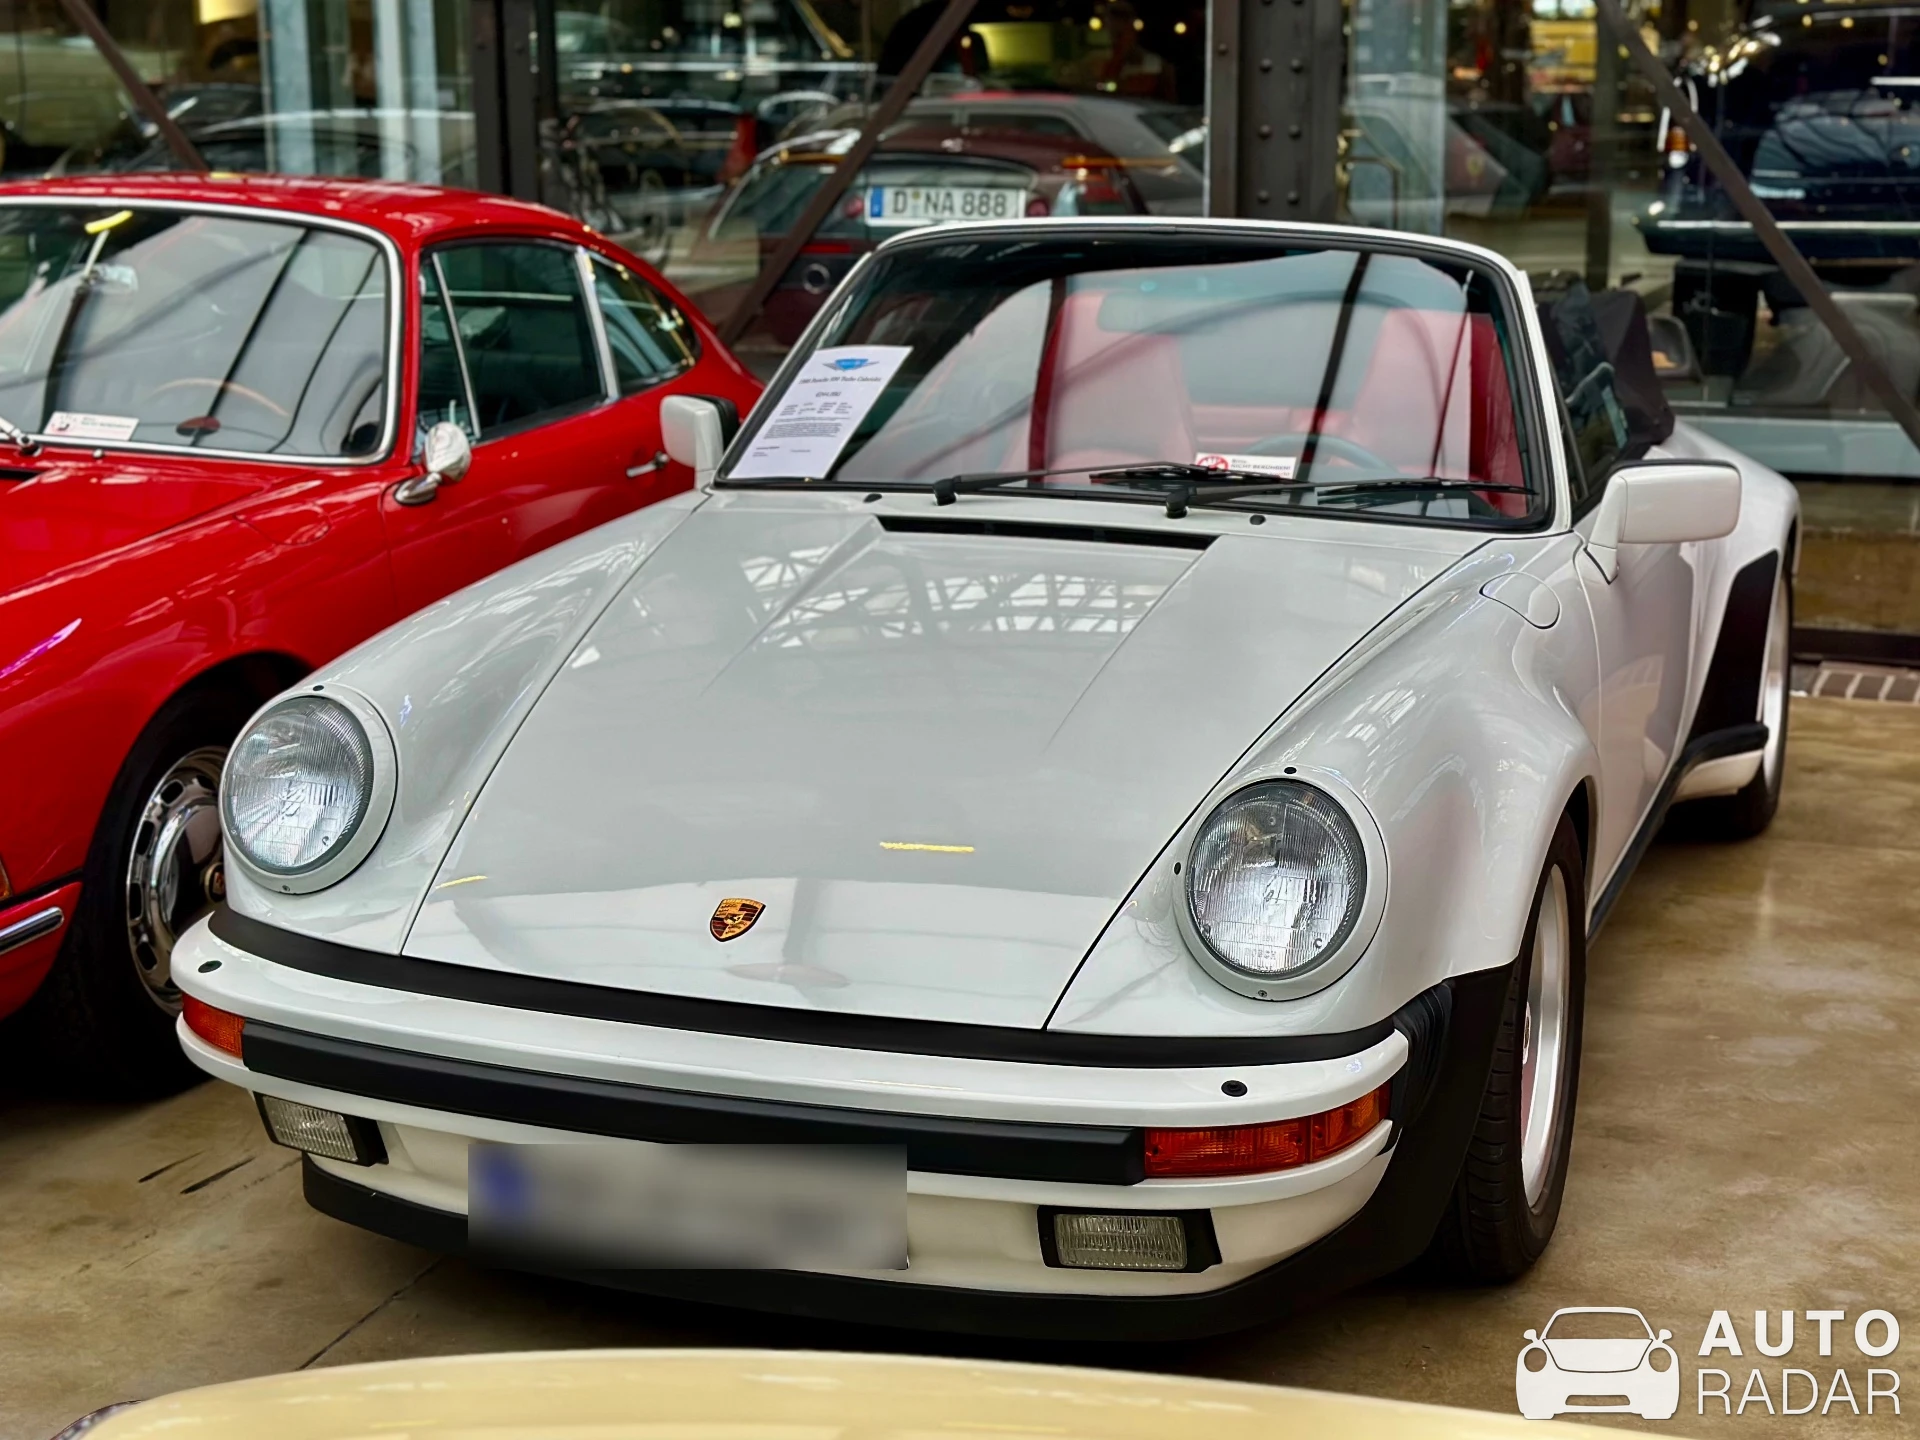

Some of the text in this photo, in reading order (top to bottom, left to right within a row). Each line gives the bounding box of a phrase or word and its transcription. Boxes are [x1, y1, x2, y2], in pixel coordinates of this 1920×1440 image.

[893, 190, 1007, 217] D NA 888
